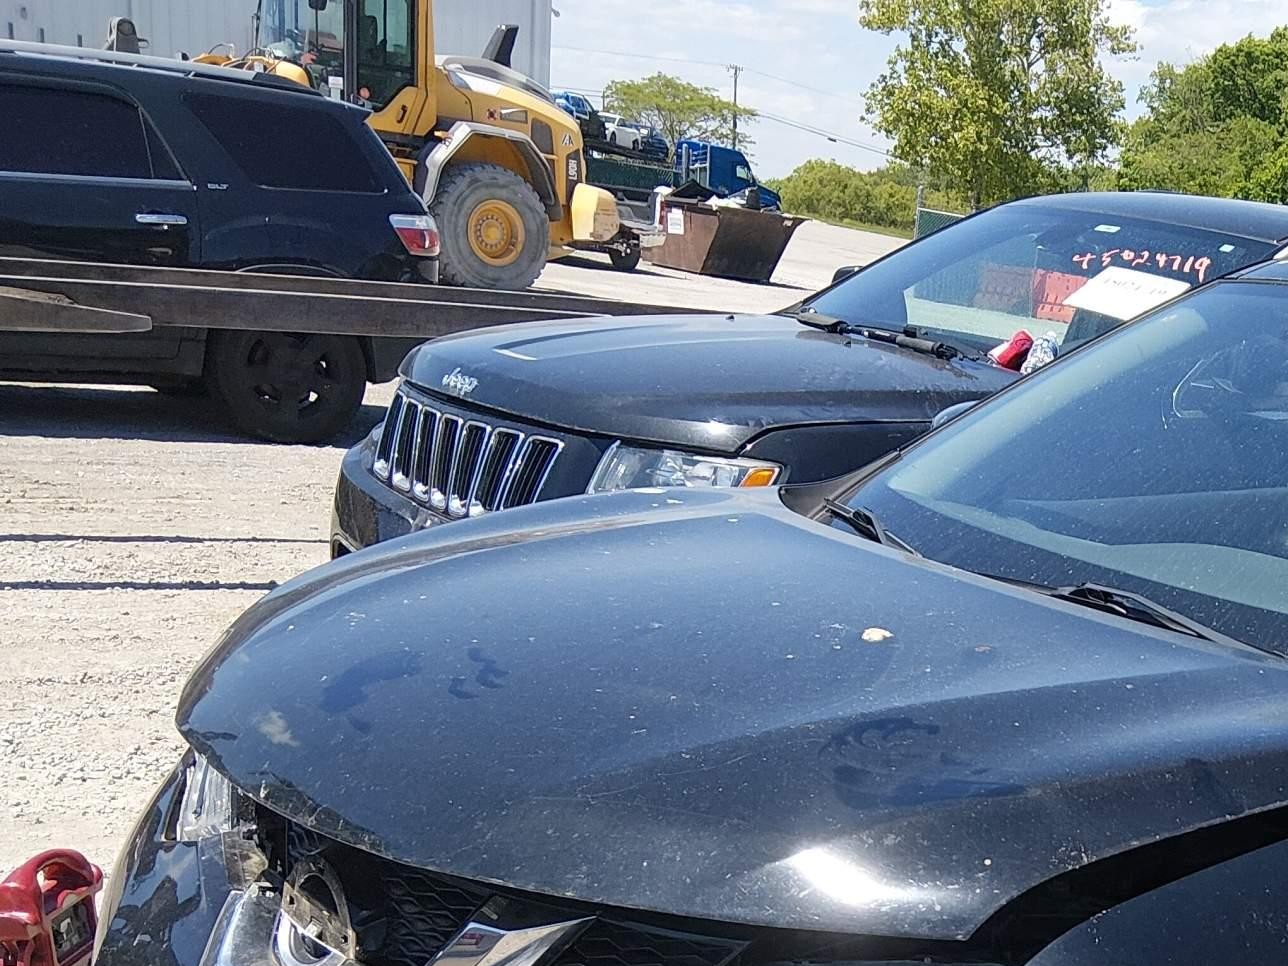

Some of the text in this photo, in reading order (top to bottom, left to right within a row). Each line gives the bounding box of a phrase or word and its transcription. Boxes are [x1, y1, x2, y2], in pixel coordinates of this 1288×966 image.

[568, 159, 578, 181] L90H
[1072, 248, 1212, 283] 45024719
[441, 367, 479, 396] Jeep
